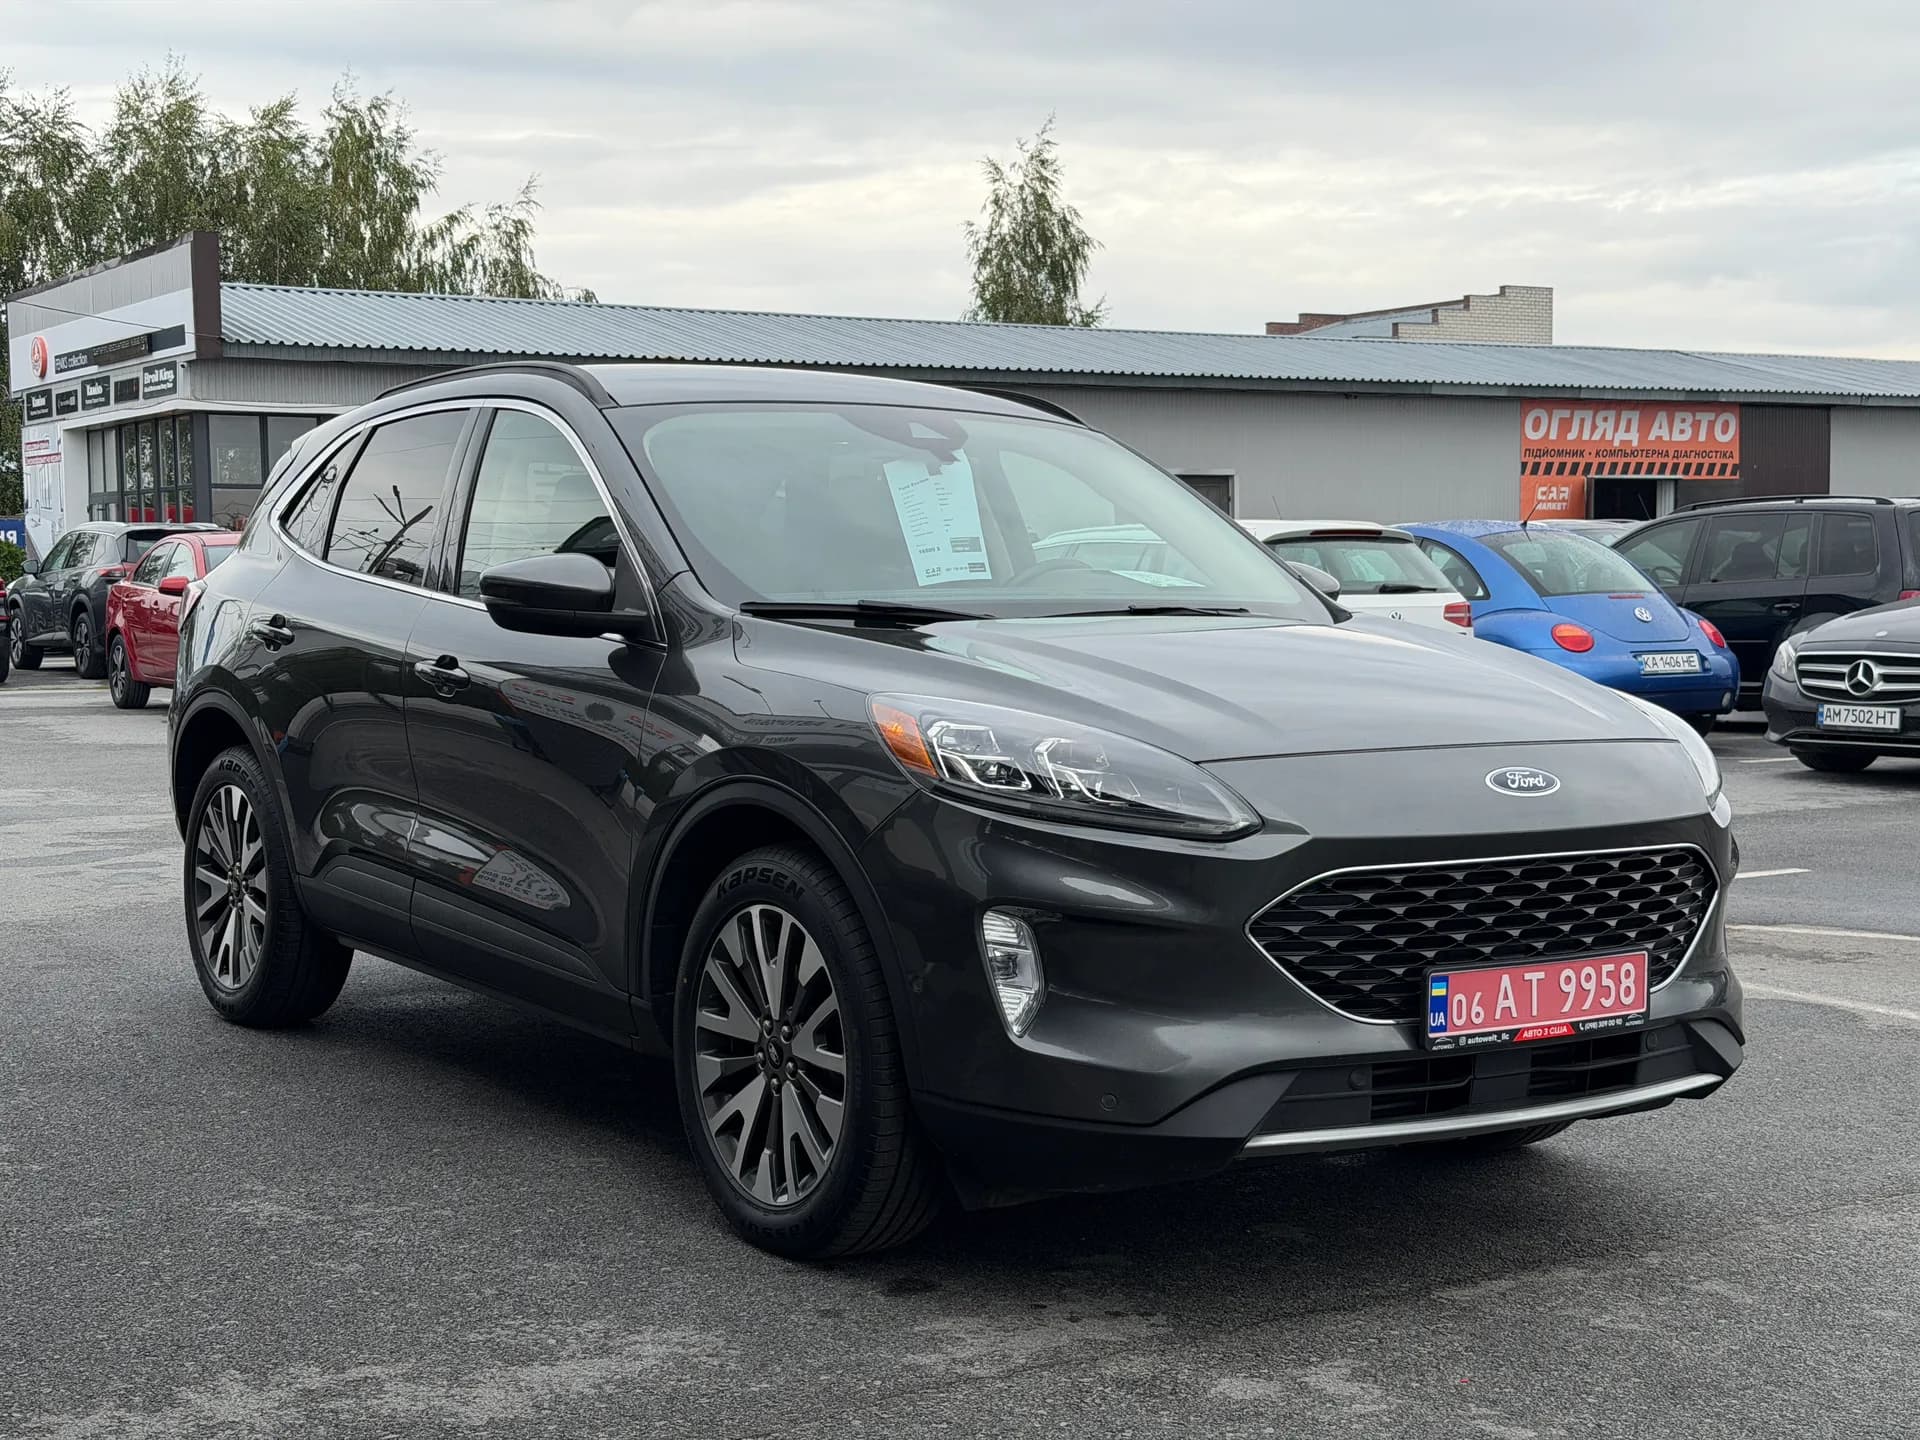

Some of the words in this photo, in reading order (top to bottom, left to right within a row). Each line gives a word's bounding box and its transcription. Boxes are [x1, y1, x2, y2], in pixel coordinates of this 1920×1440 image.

[1523, 408, 1640, 447] ОГЛЯД
[1647, 411, 1737, 443] АВТО
[1523, 447, 1585, 459] ПІДЙОМНИК
[1594, 448, 1670, 460] КОМПЬЮТЕРНА
[1671, 449, 1735, 460] ДІАГНОСТІКА
[1536, 486, 1569, 500] CAR
[1535, 502, 1568, 511] MARKET
[1506, 771, 1546, 788] Ford
[1452, 991, 1486, 1027] 06
[1494, 971, 1546, 1021] AT
[1559, 962, 1637, 1014] 9958
[1430, 1010, 1446, 1027] UA
[1522, 1028, 1543, 1039] АВТО
[1549, 1025, 1568, 1035] США
